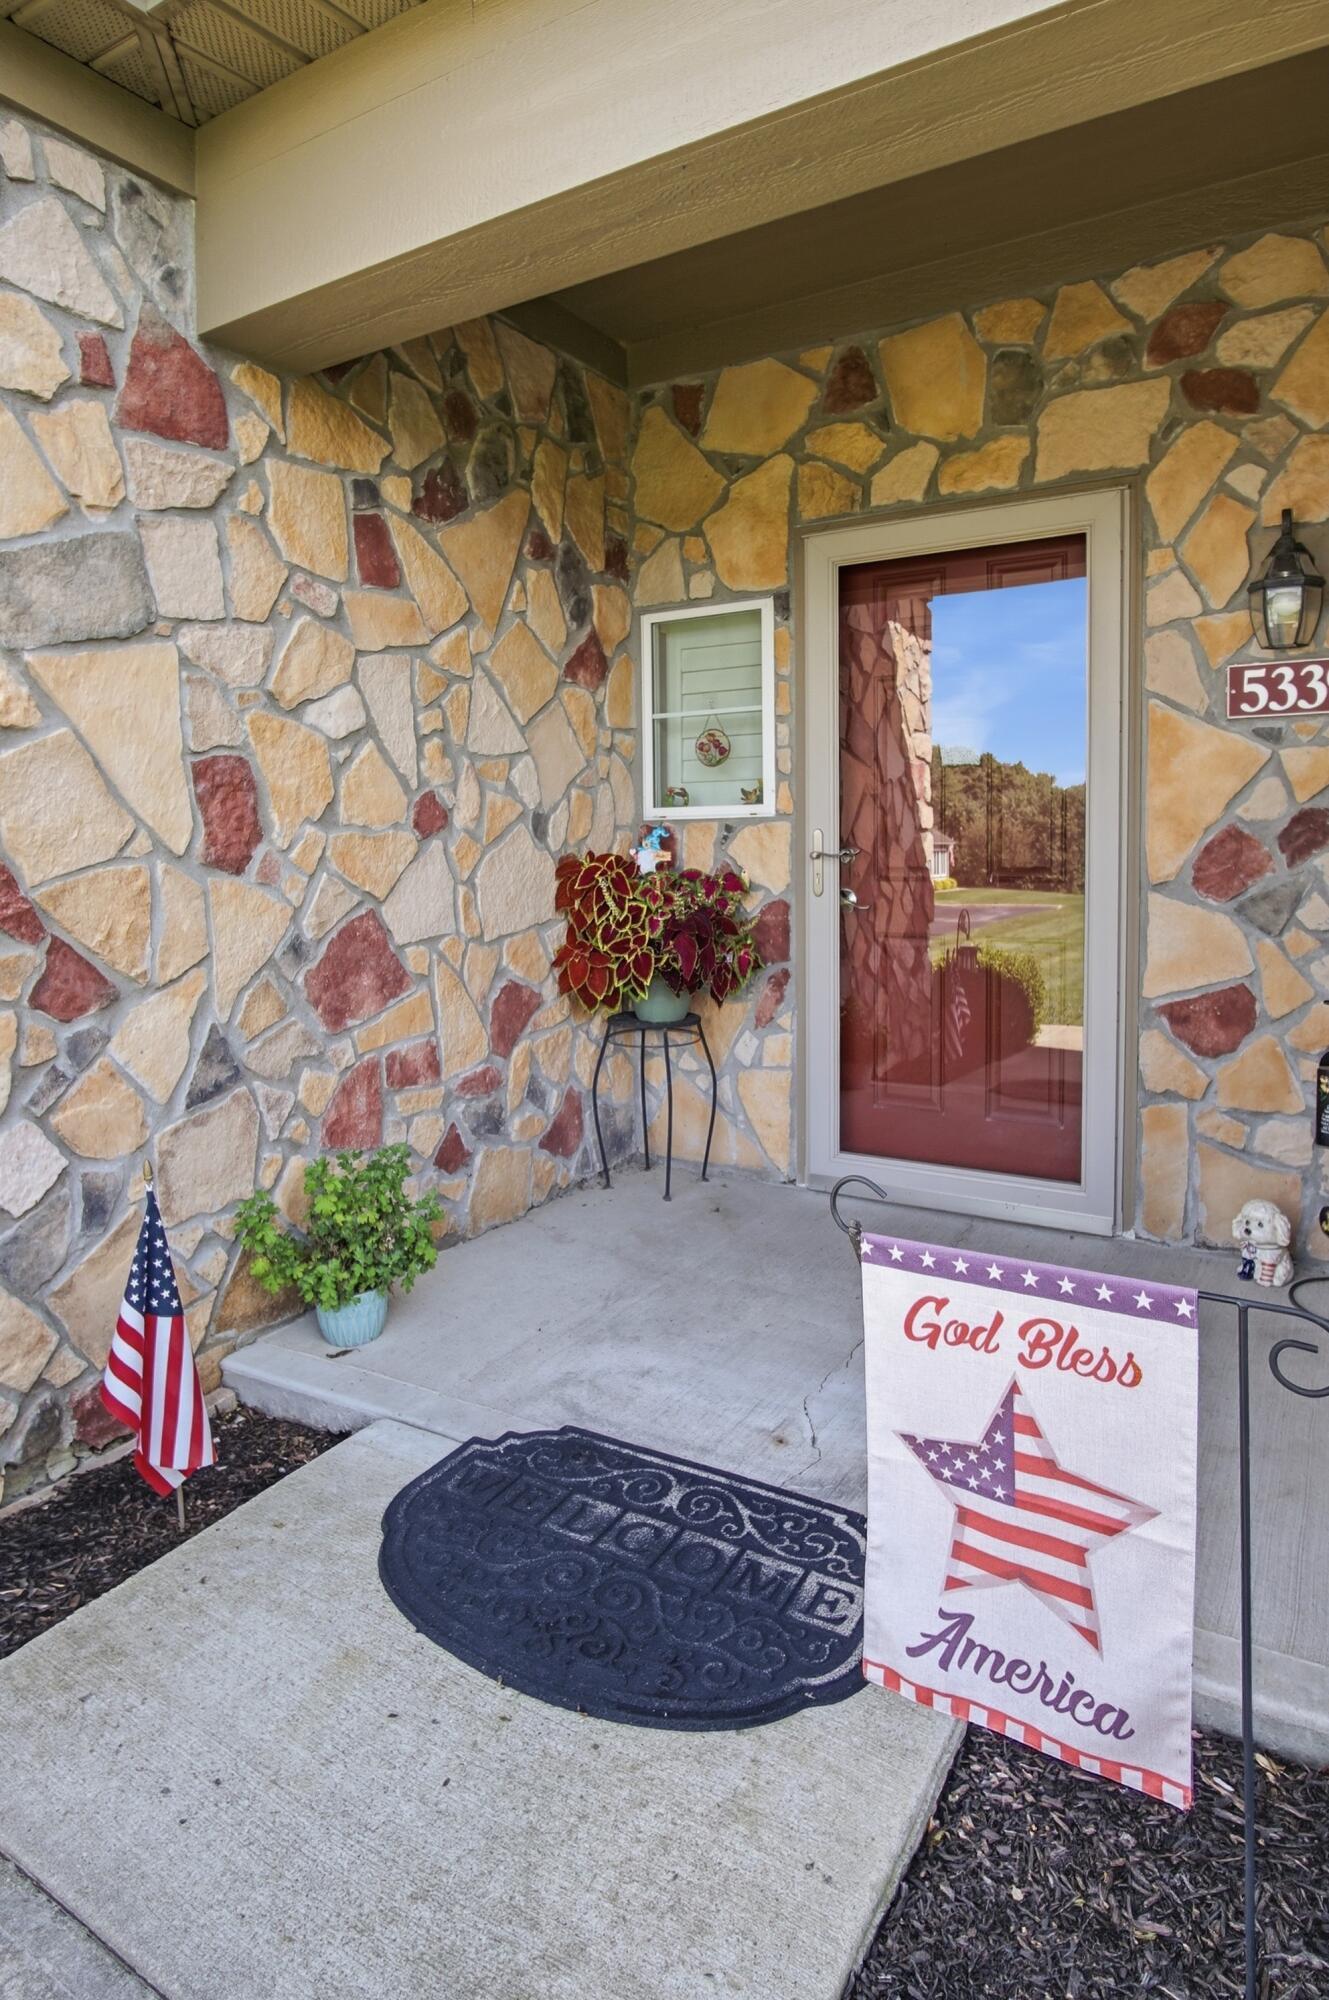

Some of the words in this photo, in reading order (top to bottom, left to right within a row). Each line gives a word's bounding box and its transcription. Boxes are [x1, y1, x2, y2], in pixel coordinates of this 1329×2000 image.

[1240, 664, 1329, 713] 533
[903, 1295, 1004, 1354] God
[1017, 1317, 1143, 1388] Bless
[455, 1466, 856, 1627] WELCOME
[905, 1607, 1135, 1740] America
